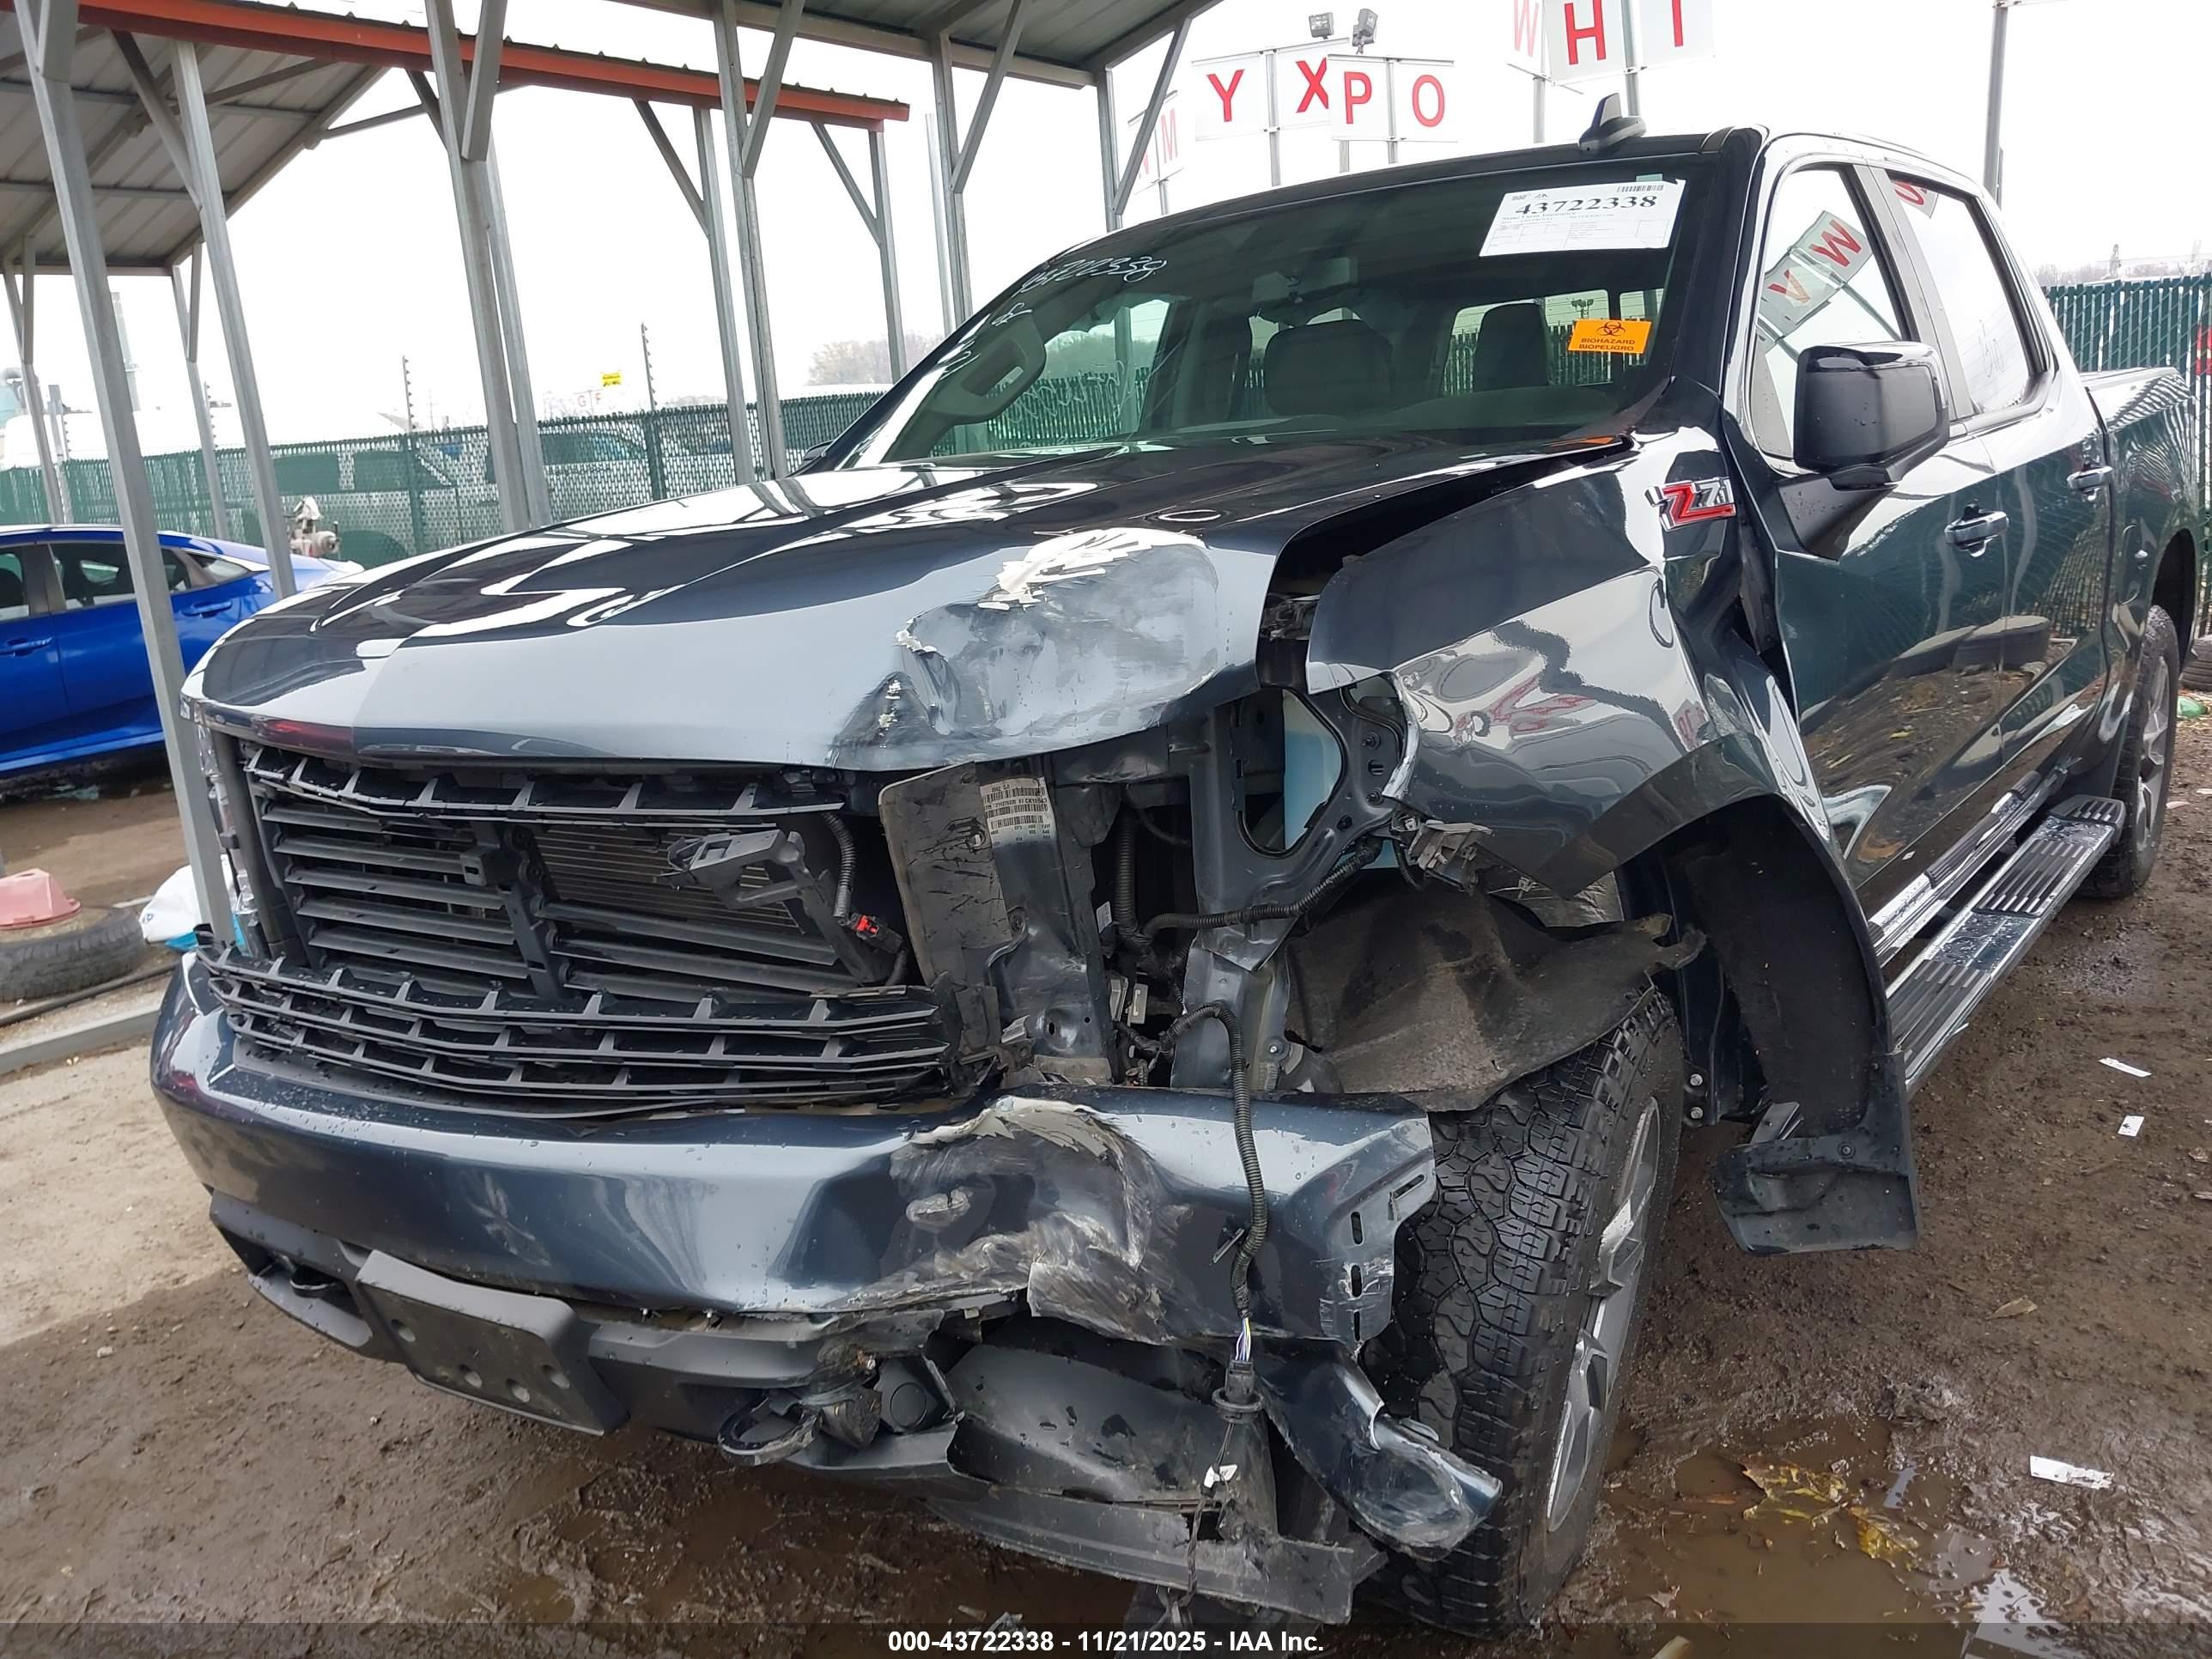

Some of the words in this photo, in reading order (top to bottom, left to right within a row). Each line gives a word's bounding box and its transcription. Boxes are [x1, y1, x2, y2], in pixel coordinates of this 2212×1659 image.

[1206, 69, 1246, 122] Y
[1295, 58, 1329, 113] X
[1344, 70, 1372, 125] P
[1412, 74, 1445, 127] O
[1516, 195, 1657, 215] 43722338
[1644, 477, 1736, 532] Z71
